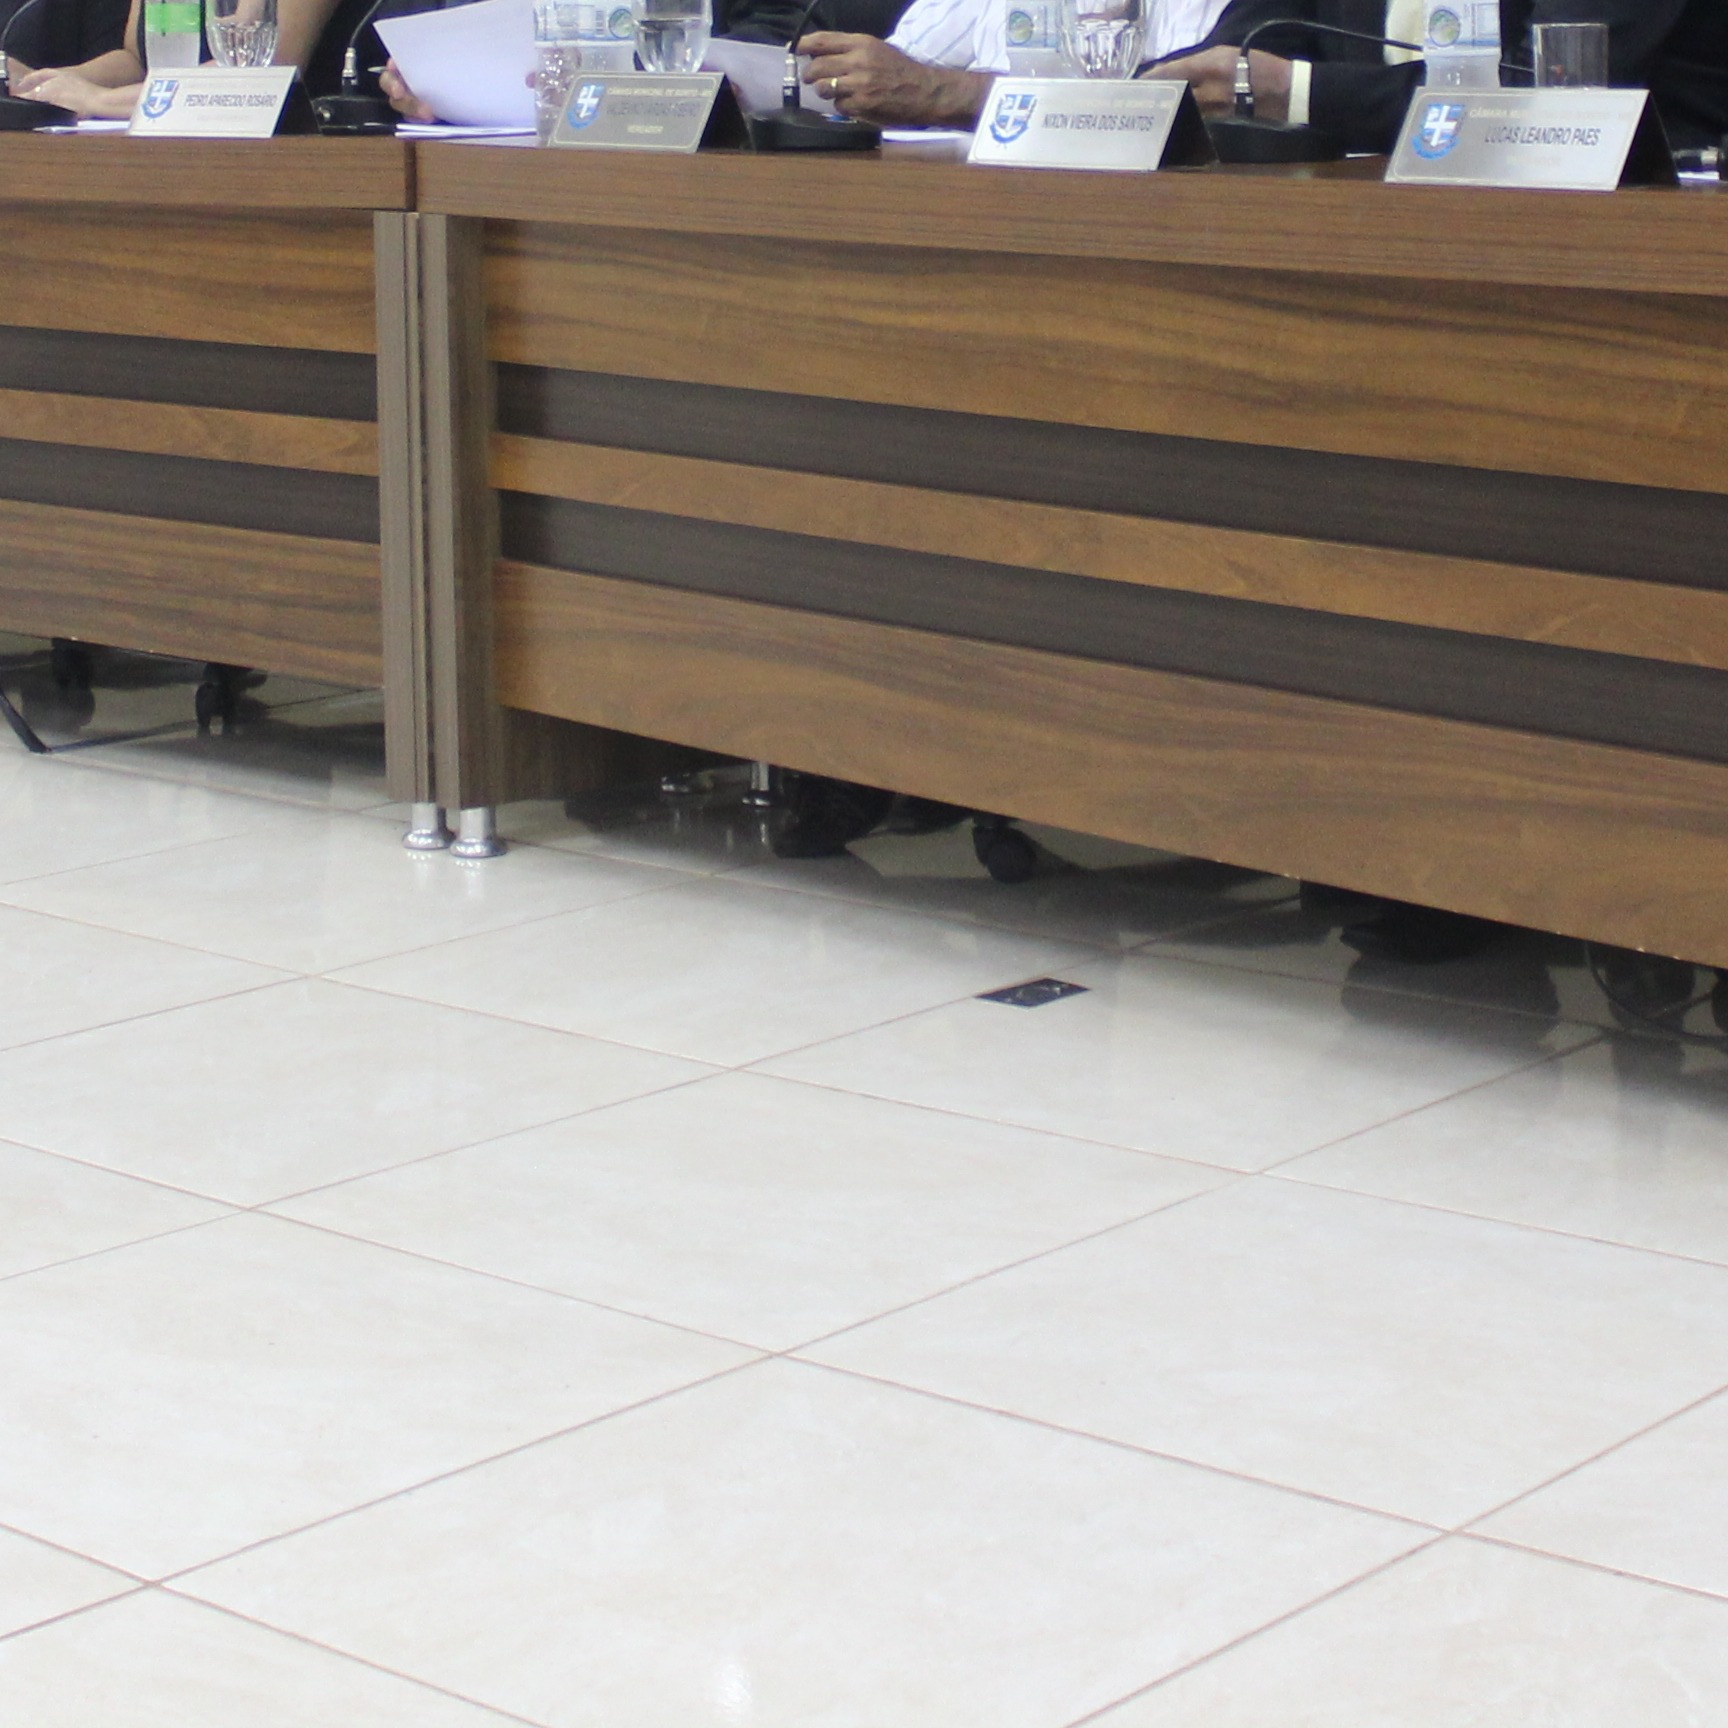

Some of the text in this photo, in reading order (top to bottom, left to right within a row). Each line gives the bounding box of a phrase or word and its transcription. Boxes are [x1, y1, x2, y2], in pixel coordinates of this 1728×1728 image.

[1484, 126, 1602, 146] LUCAS LEANDRO PAES
